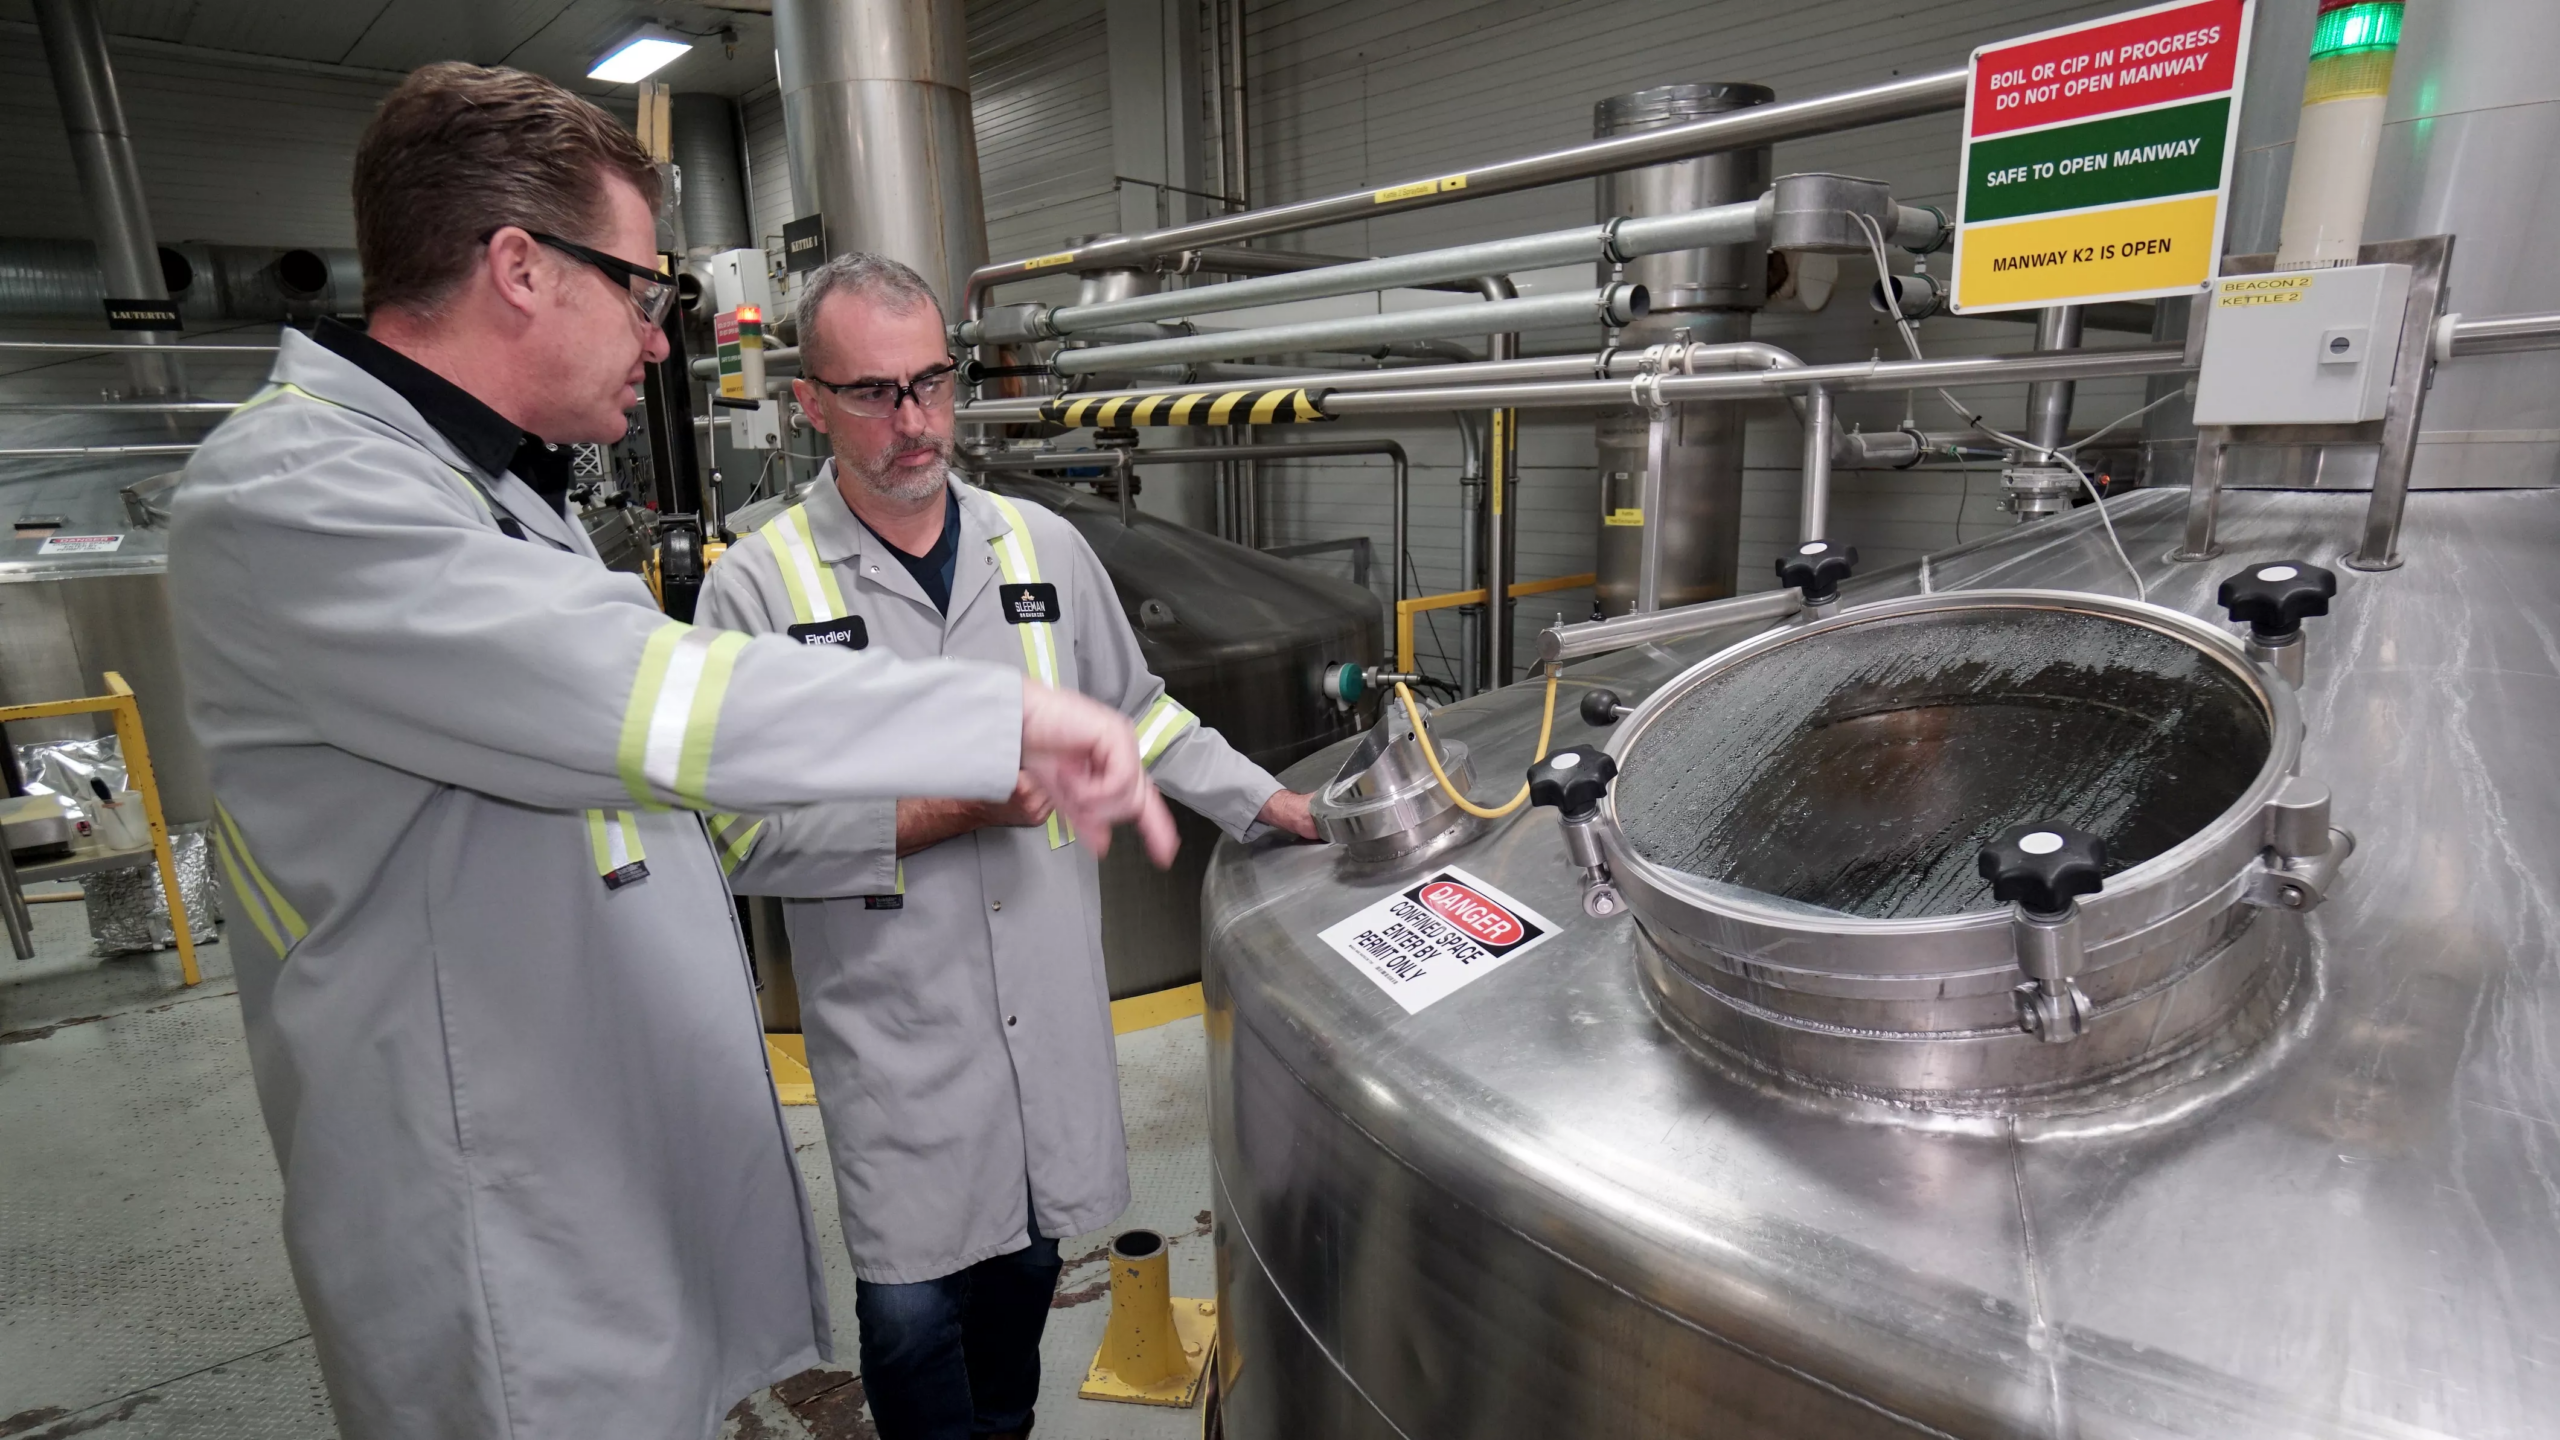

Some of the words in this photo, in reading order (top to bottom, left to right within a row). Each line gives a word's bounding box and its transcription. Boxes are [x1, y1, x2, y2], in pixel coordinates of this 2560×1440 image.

[1990, 70, 2026, 90] BOIL
[2031, 62, 2055, 82] OR
[2060, 55, 2089, 76] CIP
[2094, 49, 2114, 69] IN
[2119, 26, 2221, 64] PROGRESS
[1996, 91, 2020, 111] DO
[2025, 83, 2060, 106] NOT
[2064, 73, 2114, 97] OPEN
[2119, 52, 2209, 87] MANWAY
[1987, 166, 2027, 187] SAFE
[2032, 162, 2054, 180] TO
[2059, 154, 2108, 175] OPEN
[2113, 138, 2201, 168] MANWAY
[1993, 250, 2068, 272] MANWAY
[2072, 247, 2094, 263] K2
[2100, 244, 2115, 260] IS
[2121, 237, 2172, 258] OPEN
[2222, 294, 2284, 305] KETTLE
[2289, 293, 2299, 301] 2
[2225, 279, 2294, 292] BEACON
[2299, 278, 2309, 286] 2
[111, 311, 176, 320] LAUTERTUN
[1014, 601, 1045, 612] SLEEMAN
[805, 629, 851, 645] Findley
[1389, 901, 1446, 940] CONFINED
[1435, 932, 1485, 965] SPACE
[1427, 885, 1512, 941] DANGER
[1353, 929, 1400, 962] PERMIT
[1386, 955, 1427, 982] ONLY
[1382, 923, 1426, 954] ENTER
[1418, 945, 1442, 963] BY
